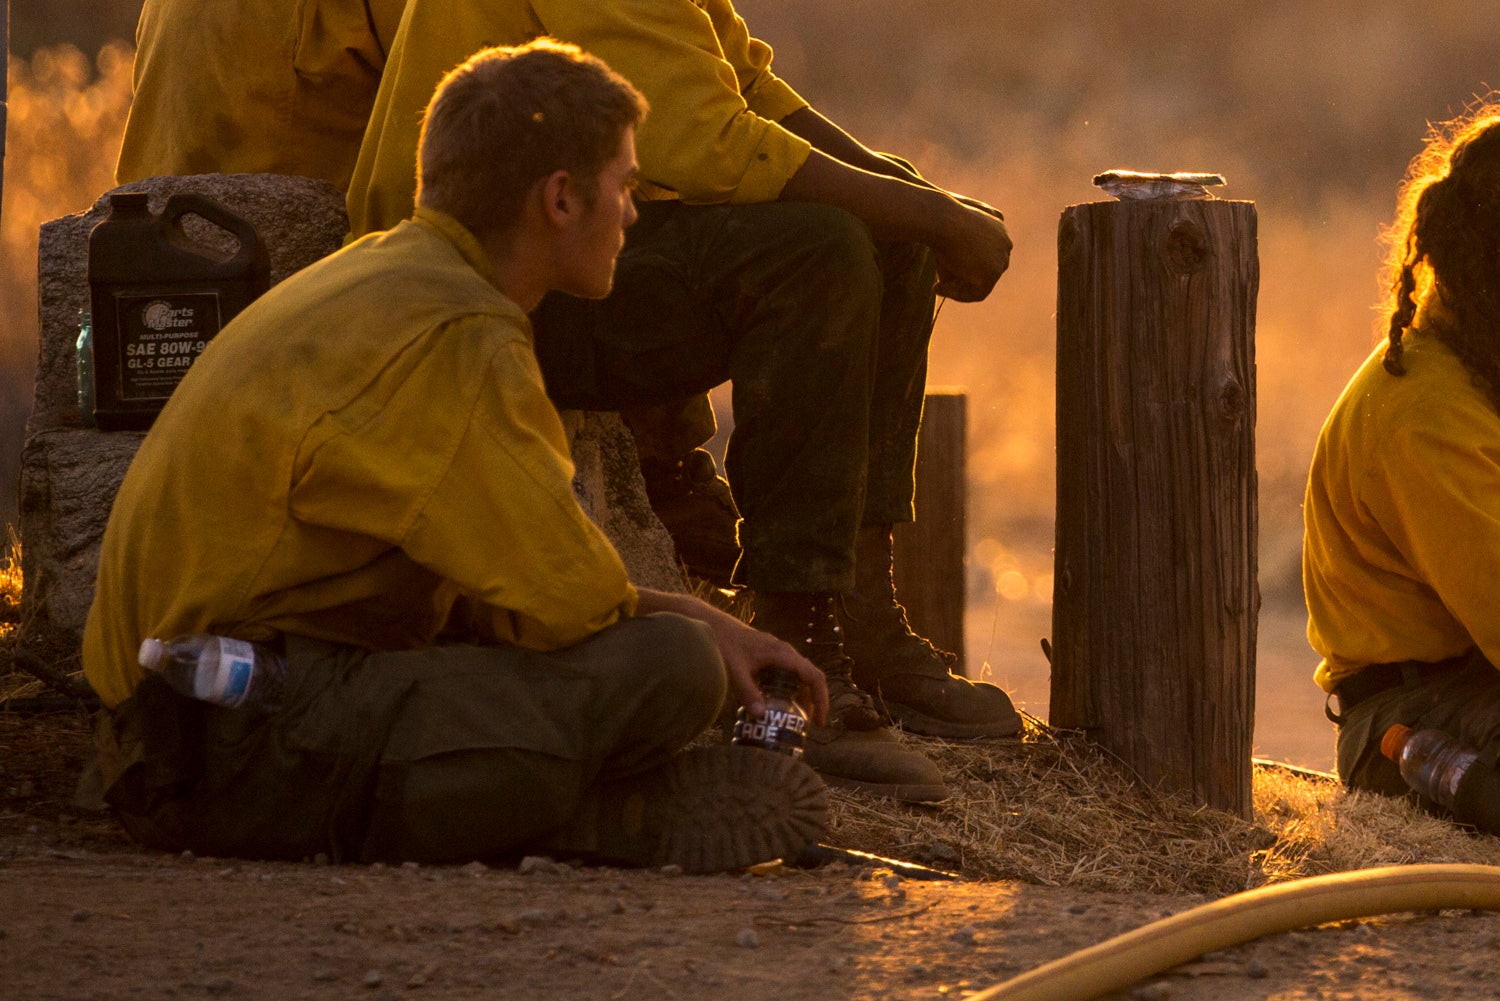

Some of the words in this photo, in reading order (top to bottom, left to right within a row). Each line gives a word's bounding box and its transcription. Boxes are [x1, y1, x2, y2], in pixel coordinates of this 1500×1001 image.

[159, 307, 194, 317] Parts
[148, 318, 193, 329] Master
[139, 332, 199, 340] MULTI-PURPOSE
[126, 343, 156, 356] SAE
[127, 358, 154, 369] GL-5
[157, 356, 191, 368] GEAR
